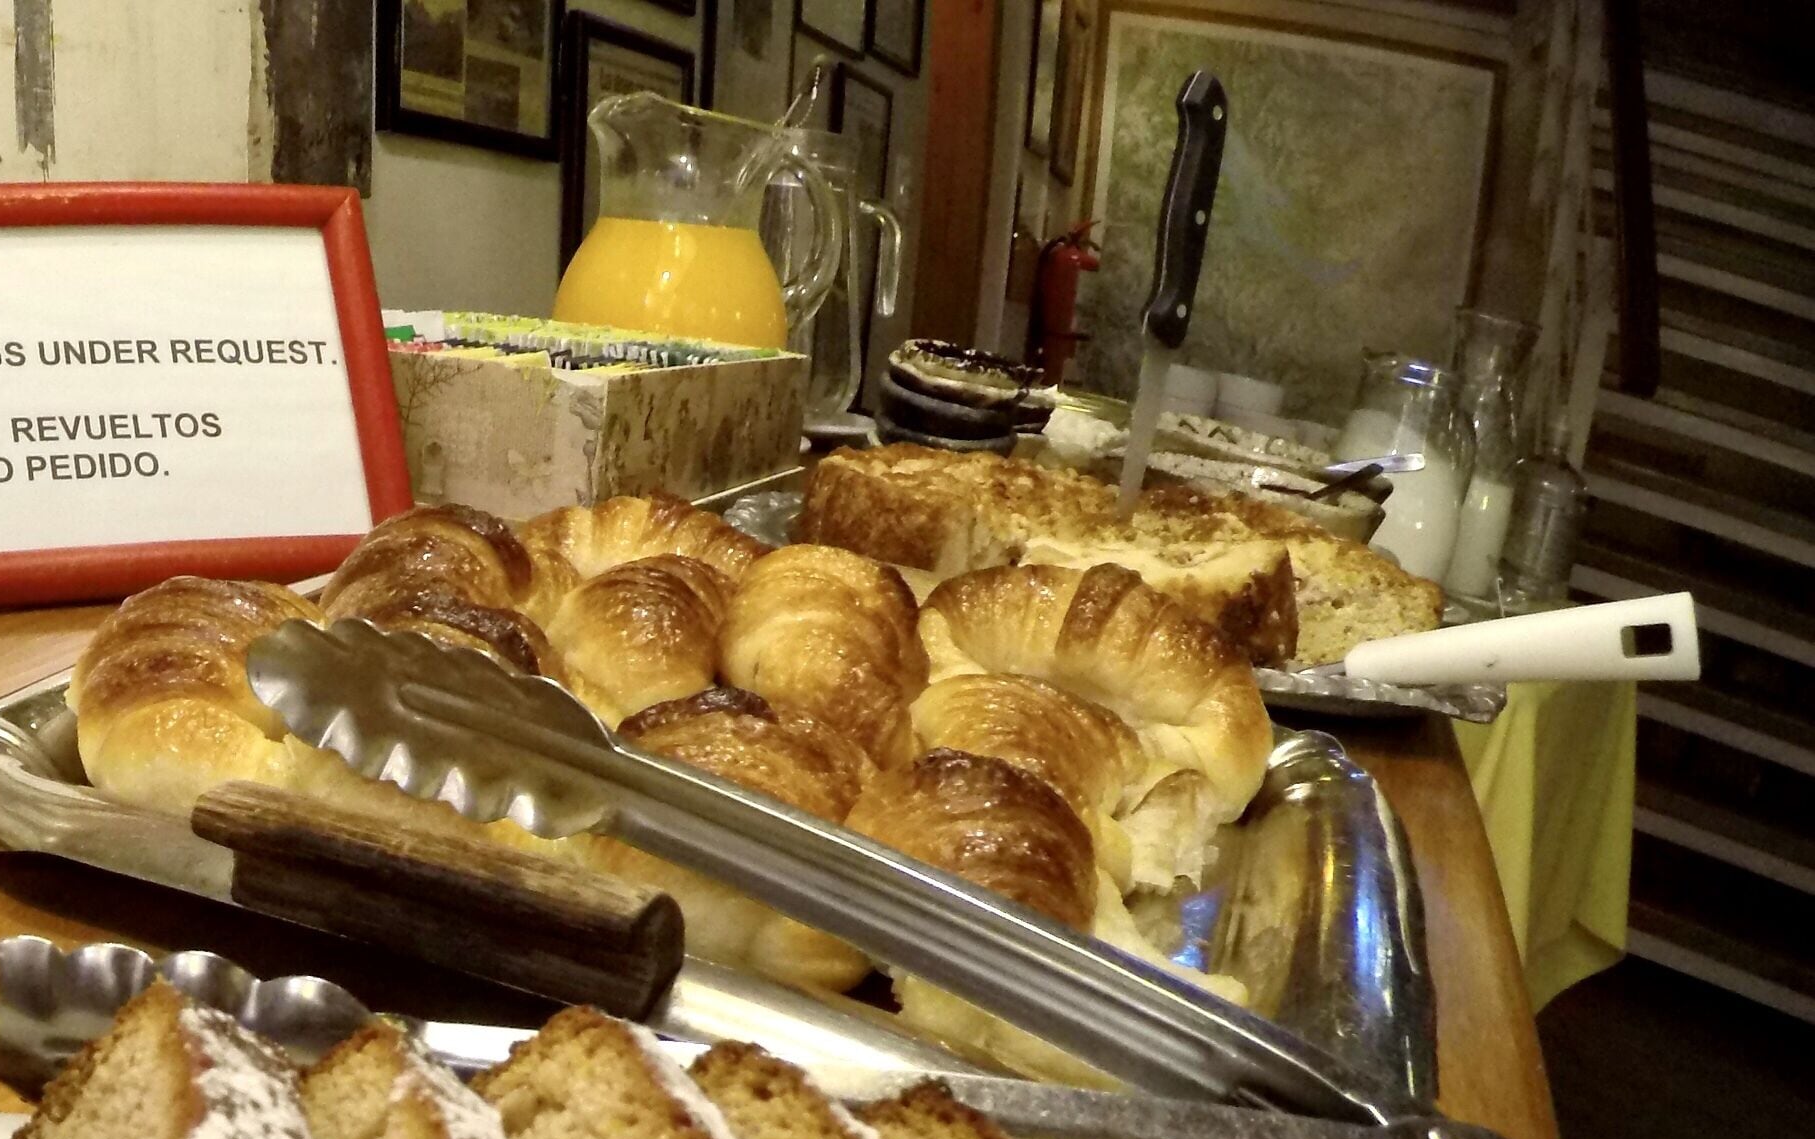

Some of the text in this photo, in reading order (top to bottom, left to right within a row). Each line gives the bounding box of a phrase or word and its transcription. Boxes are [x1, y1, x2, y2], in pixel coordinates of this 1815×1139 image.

[37, 338, 161, 367] UNDER
[169, 338, 338, 366] REQUEST.
[10, 411, 223, 444] REVUELTOS
[25, 451, 170, 482] PEDIDO.
